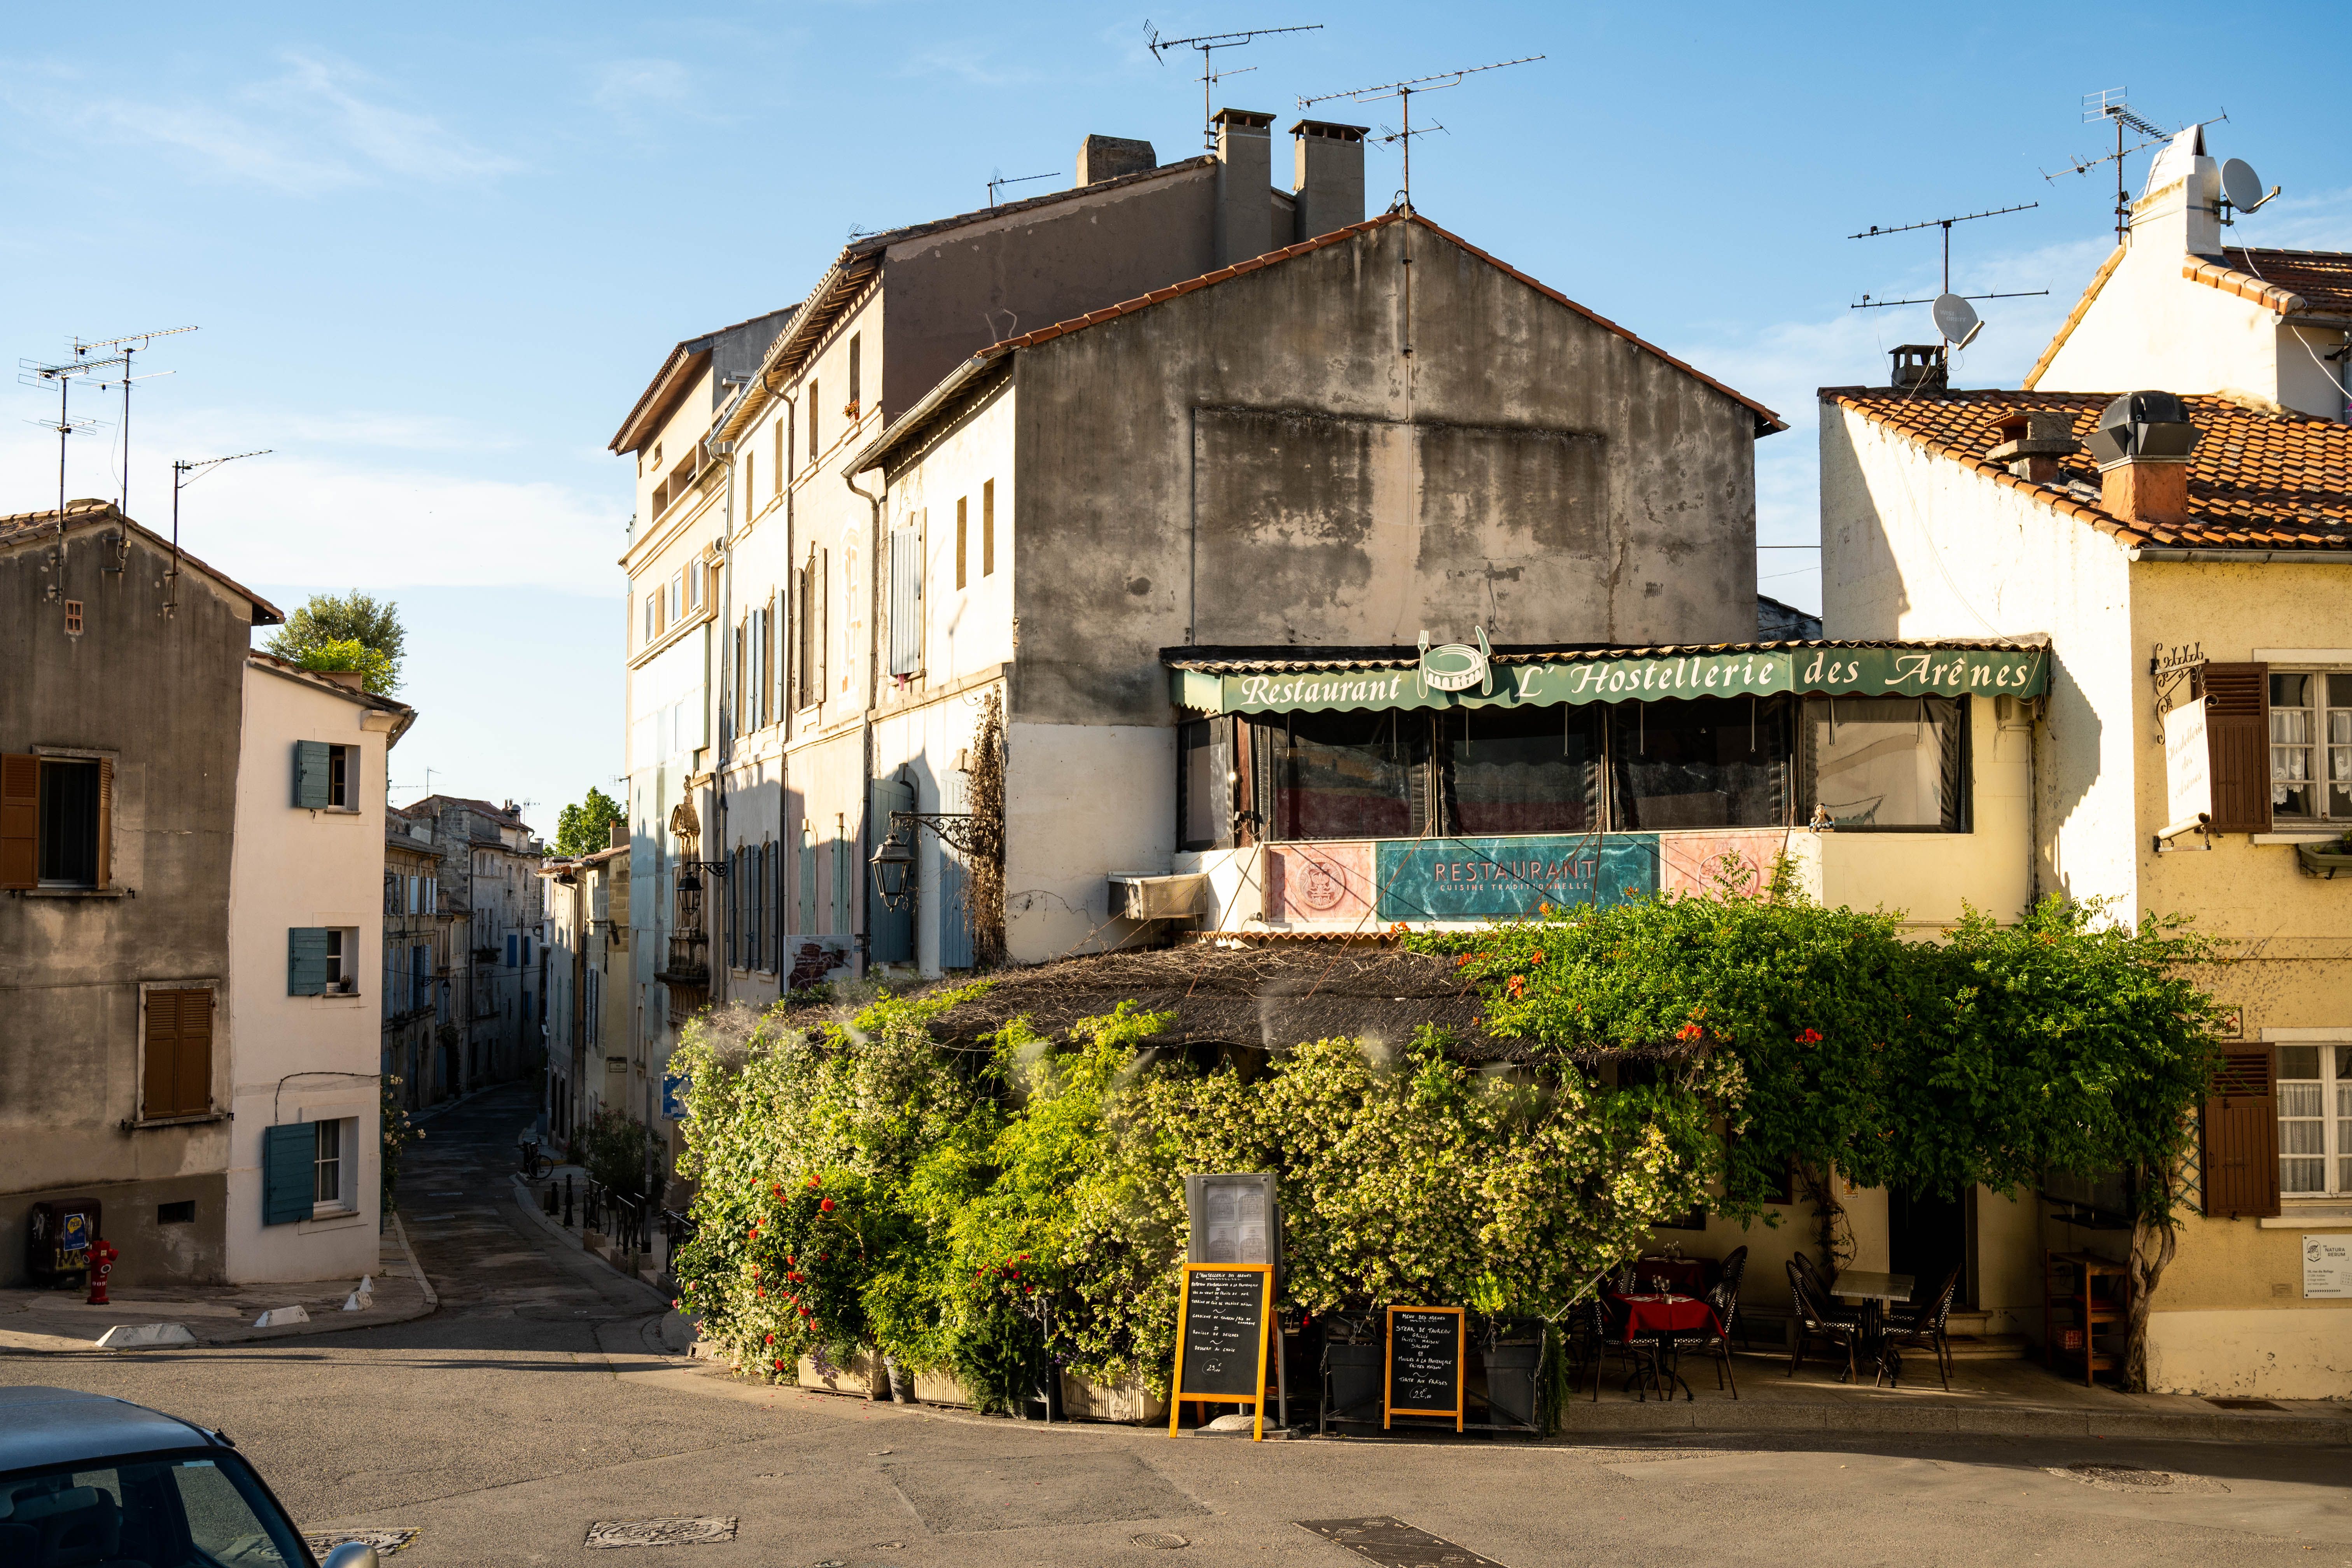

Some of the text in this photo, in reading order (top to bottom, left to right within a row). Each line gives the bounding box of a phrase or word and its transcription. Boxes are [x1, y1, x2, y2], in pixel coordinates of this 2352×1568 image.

[1241, 673, 1402, 705] Restaurant
[1571, 656, 1774, 693] Hostellerie
[1804, 651, 1859, 684] des
[1885, 654, 2028, 686] Arênes
[2168, 723, 2203, 761] Hostellerie
[2182, 756, 2192, 770] des
[1434, 859, 1595, 882] RESTAURANT
